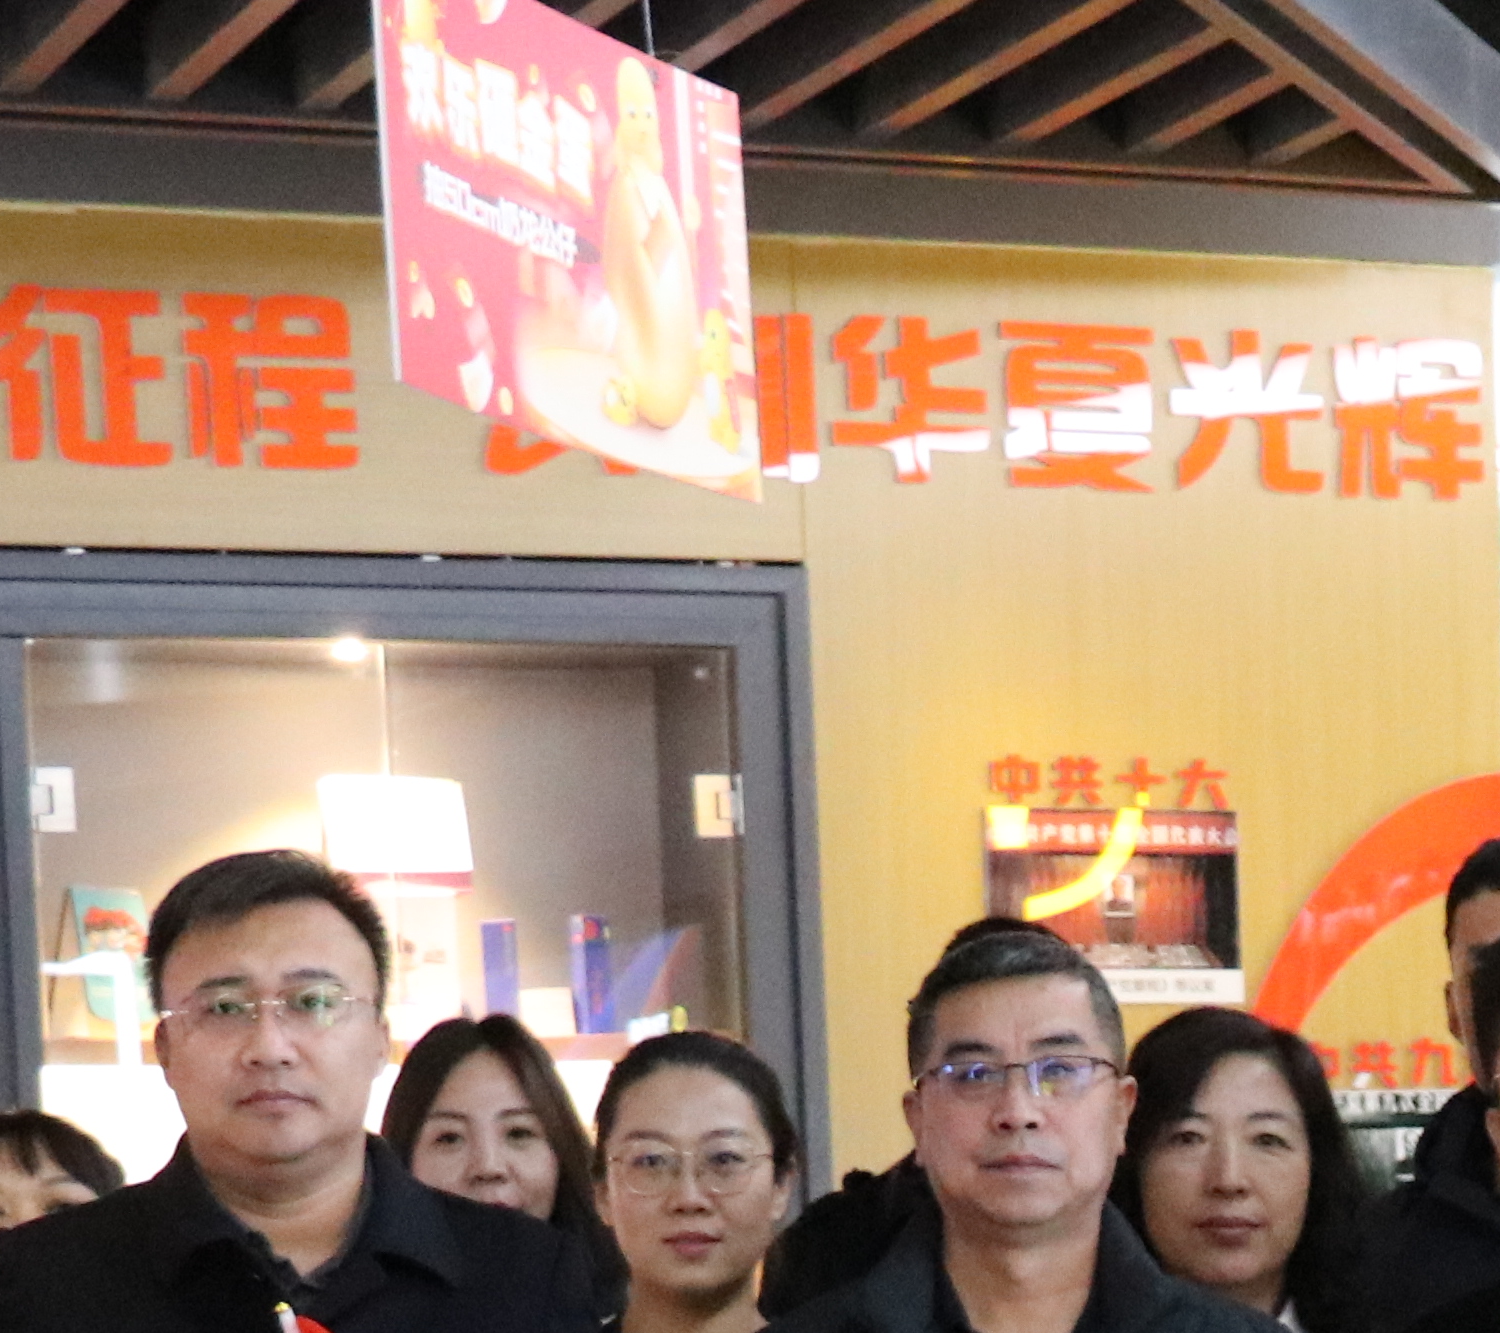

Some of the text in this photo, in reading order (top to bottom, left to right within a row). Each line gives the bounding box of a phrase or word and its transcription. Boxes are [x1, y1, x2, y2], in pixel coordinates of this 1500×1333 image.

[485, 313, 1484, 500] 华夏光辉
[988, 753, 1229, 810] 中共十大
